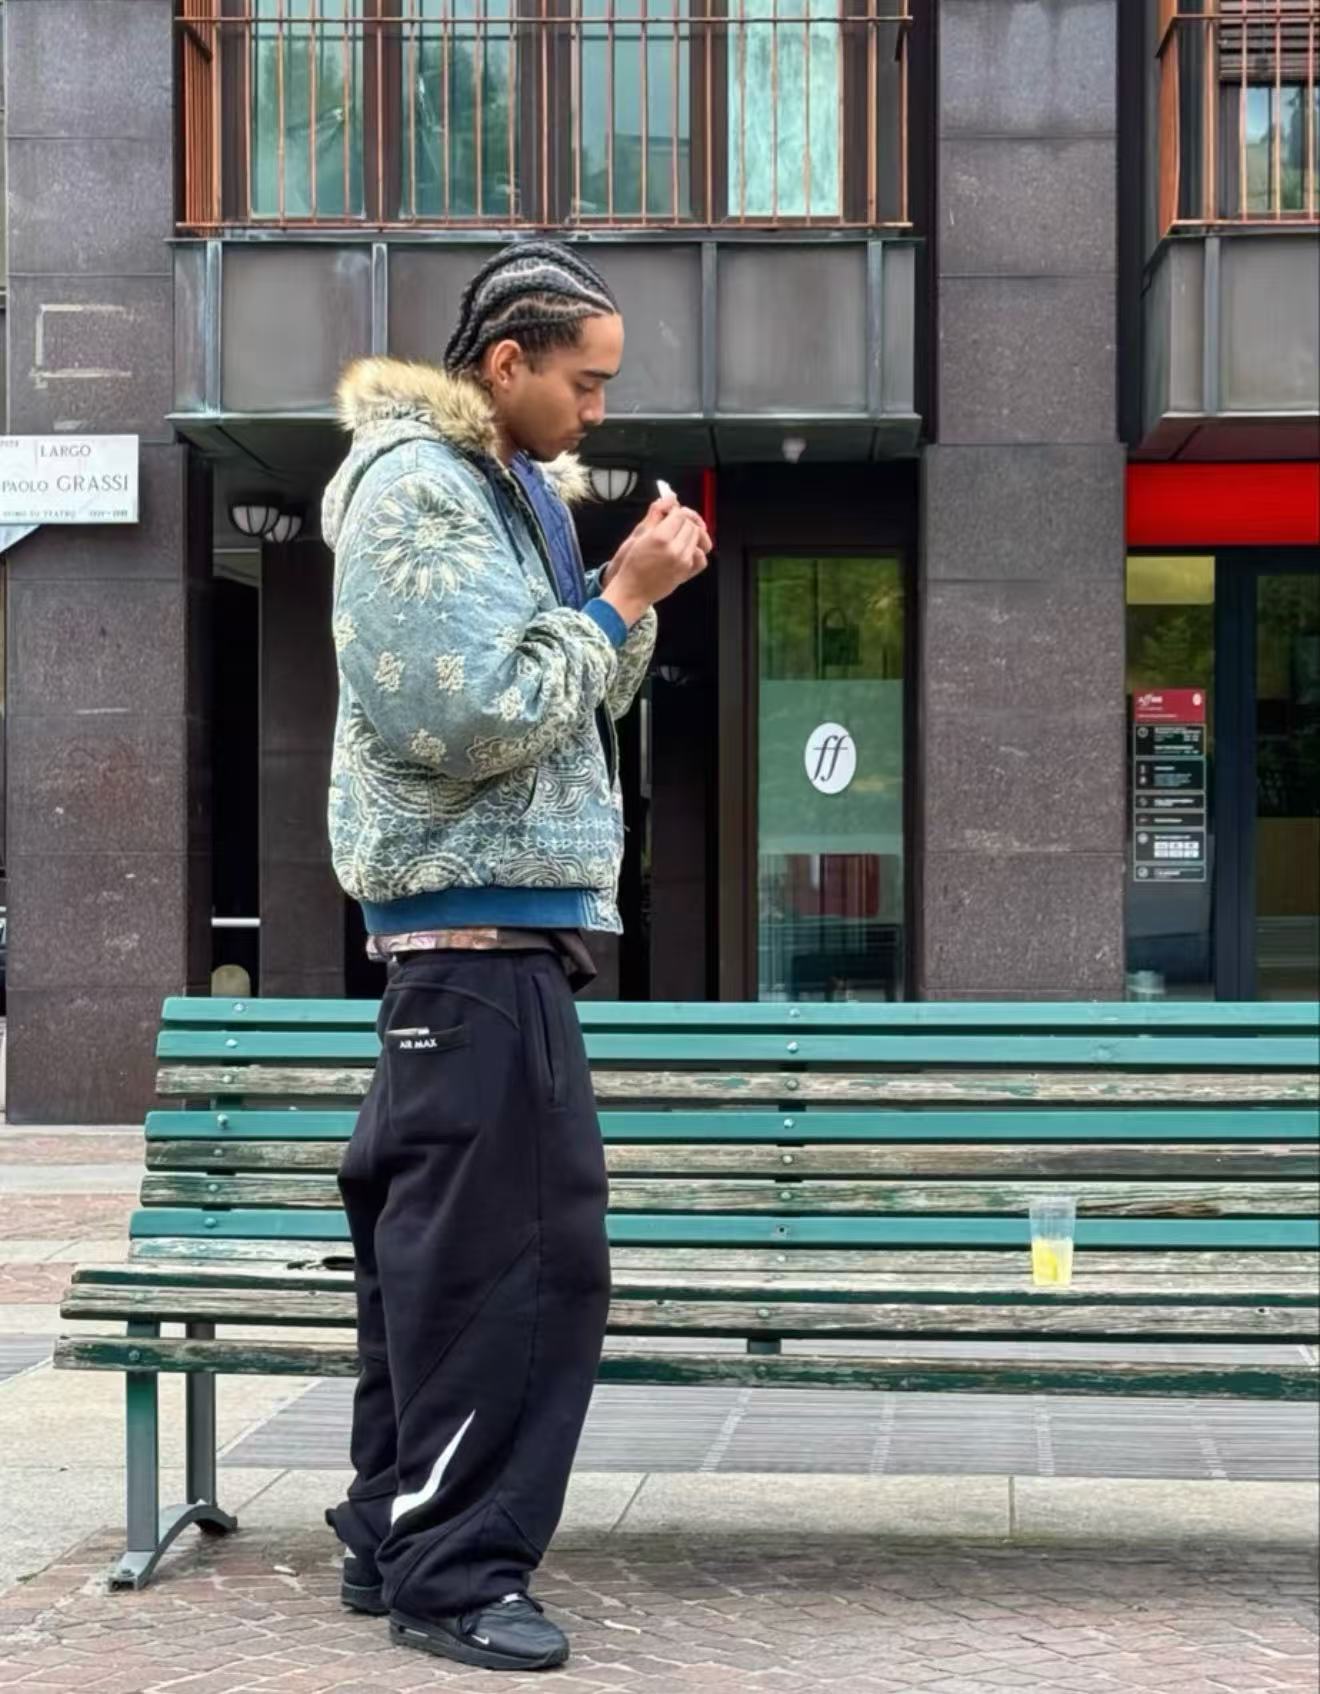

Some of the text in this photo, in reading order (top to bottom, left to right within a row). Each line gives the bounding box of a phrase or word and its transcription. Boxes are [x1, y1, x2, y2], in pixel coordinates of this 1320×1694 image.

[40, 444, 91, 457] LARGO
[2, 474, 128, 493] PAOLO GRASSI
[812, 735, 848, 782] ff
[399, 1038, 437, 1049] AIR MAX
